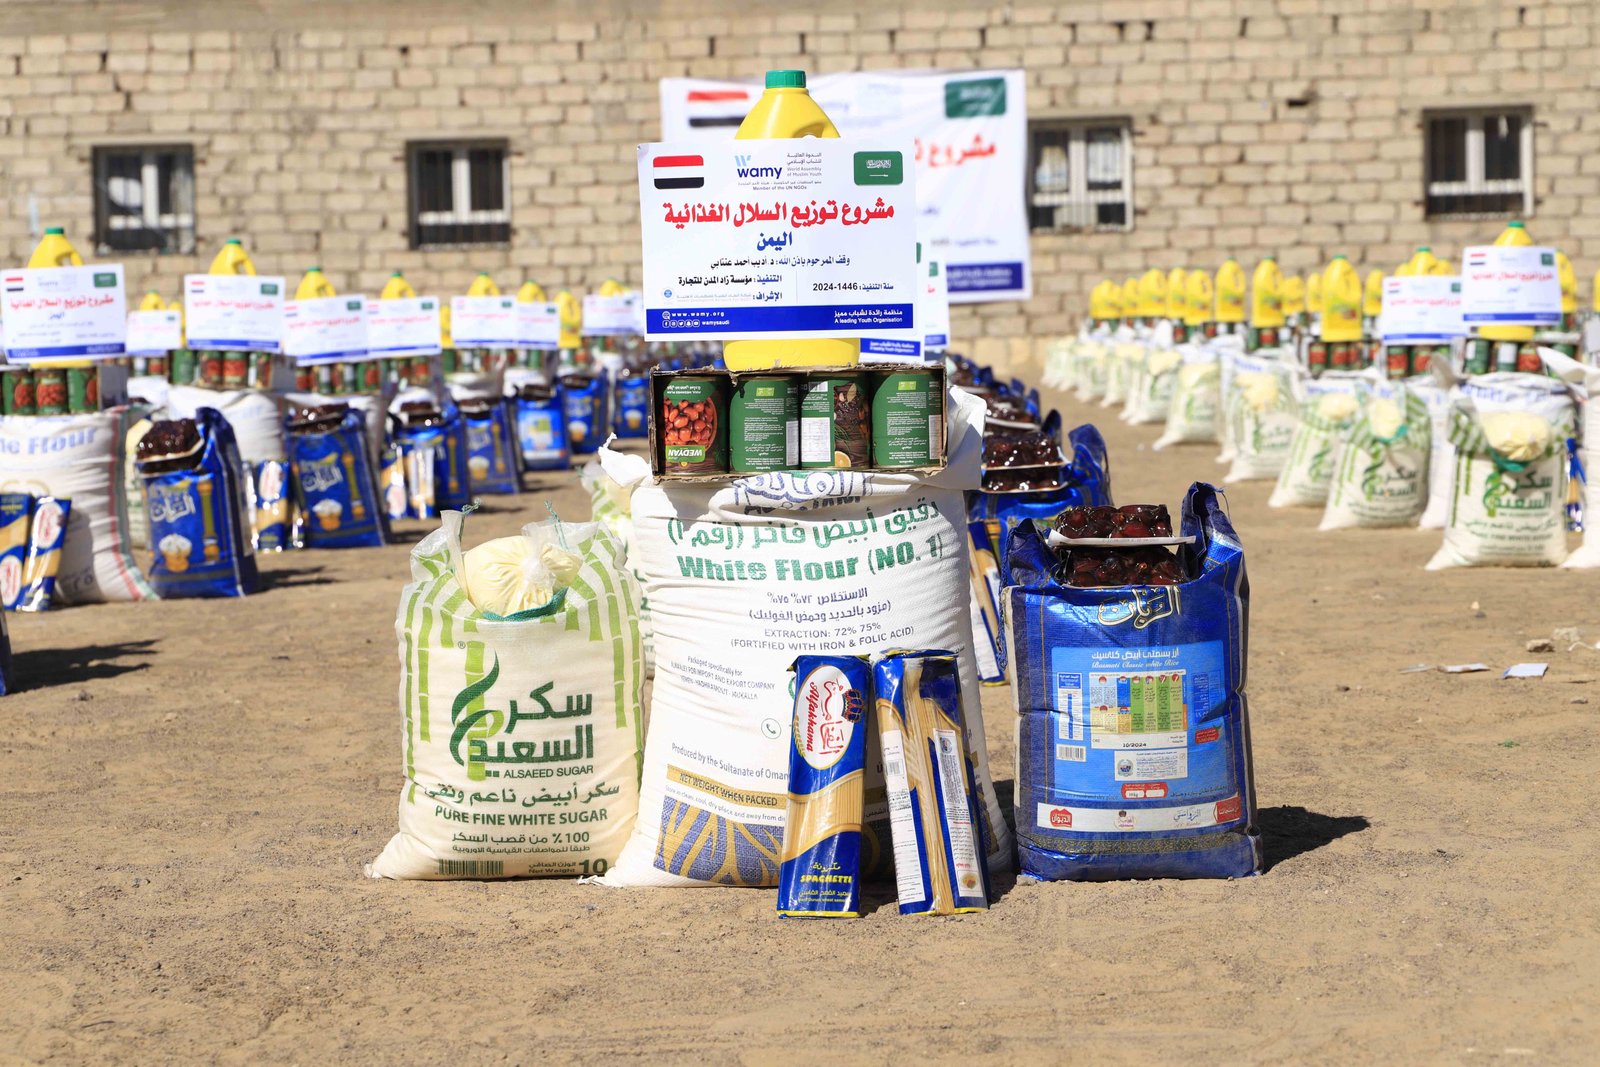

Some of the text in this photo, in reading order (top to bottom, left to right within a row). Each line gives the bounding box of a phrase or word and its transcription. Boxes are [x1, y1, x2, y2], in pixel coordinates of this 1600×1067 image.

[929, 134, 996, 167] مشروع
[737, 167, 782, 180] wamy
[663, 197, 894, 229] مشروع توزيع السلال الغذائية
[756, 231, 792, 251] اليمن
[734, 256, 750, 266] أحمد
[807, 256, 834, 266] المرحوم
[836, 255, 850, 266] وقف
[678, 276, 702, 286] للتجارة
[704, 276, 718, 286] المدن
[720, 276, 730, 285] زاد
[730, 275, 752, 285] مؤسسة
[834, 310, 848, 318] مميز
[28, 427, 97, 455] Flour
[668, 449, 702, 457] WEDYAN
[885, 497, 939, 535] دقيق
[752, 521, 806, 549] فاخر
[813, 507, 878, 548] أبيض
[677, 556, 768, 581] White
[775, 557, 858, 581] Flour
[868, 541, 922, 575] (NO.
[829, 606, 864, 622] بالحديد
[731, 626, 914, 650] (FORTIFIED WITH IRON & FOLIC ACID)
[765, 622, 882, 638] EXTRACTION: 72% 75%
[726, 678, 746, 688] EXPORT
[747, 680, 776, 690] COMPANY
[505, 681, 592, 734] سكر
[805, 682, 820, 752] Alfakhama
[818, 678, 846, 755] الفخامة
[469, 724, 594, 778] السعيد
[672, 742, 788, 781] Produced by the Sultanate of Oman
[504, 765, 594, 779] ALSAEED SUGAR
[470, 782, 620, 808] سكر أبيض ناعم
[680, 772, 778, 807] NET WEIGHT WHEN PACKED
[436, 805, 608, 826] PURE FINE WHITE SUGAR
[708, 801, 718, 810] dry
[734, 810, 745, 818] and
[452, 832, 488, 843] السكر
[491, 834, 526, 846] قصب
[529, 834, 548, 844] من
[486, 846, 522, 854] القياسية
[579, 858, 608, 876] 10
[800, 875, 852, 884] SPAGHETTI
